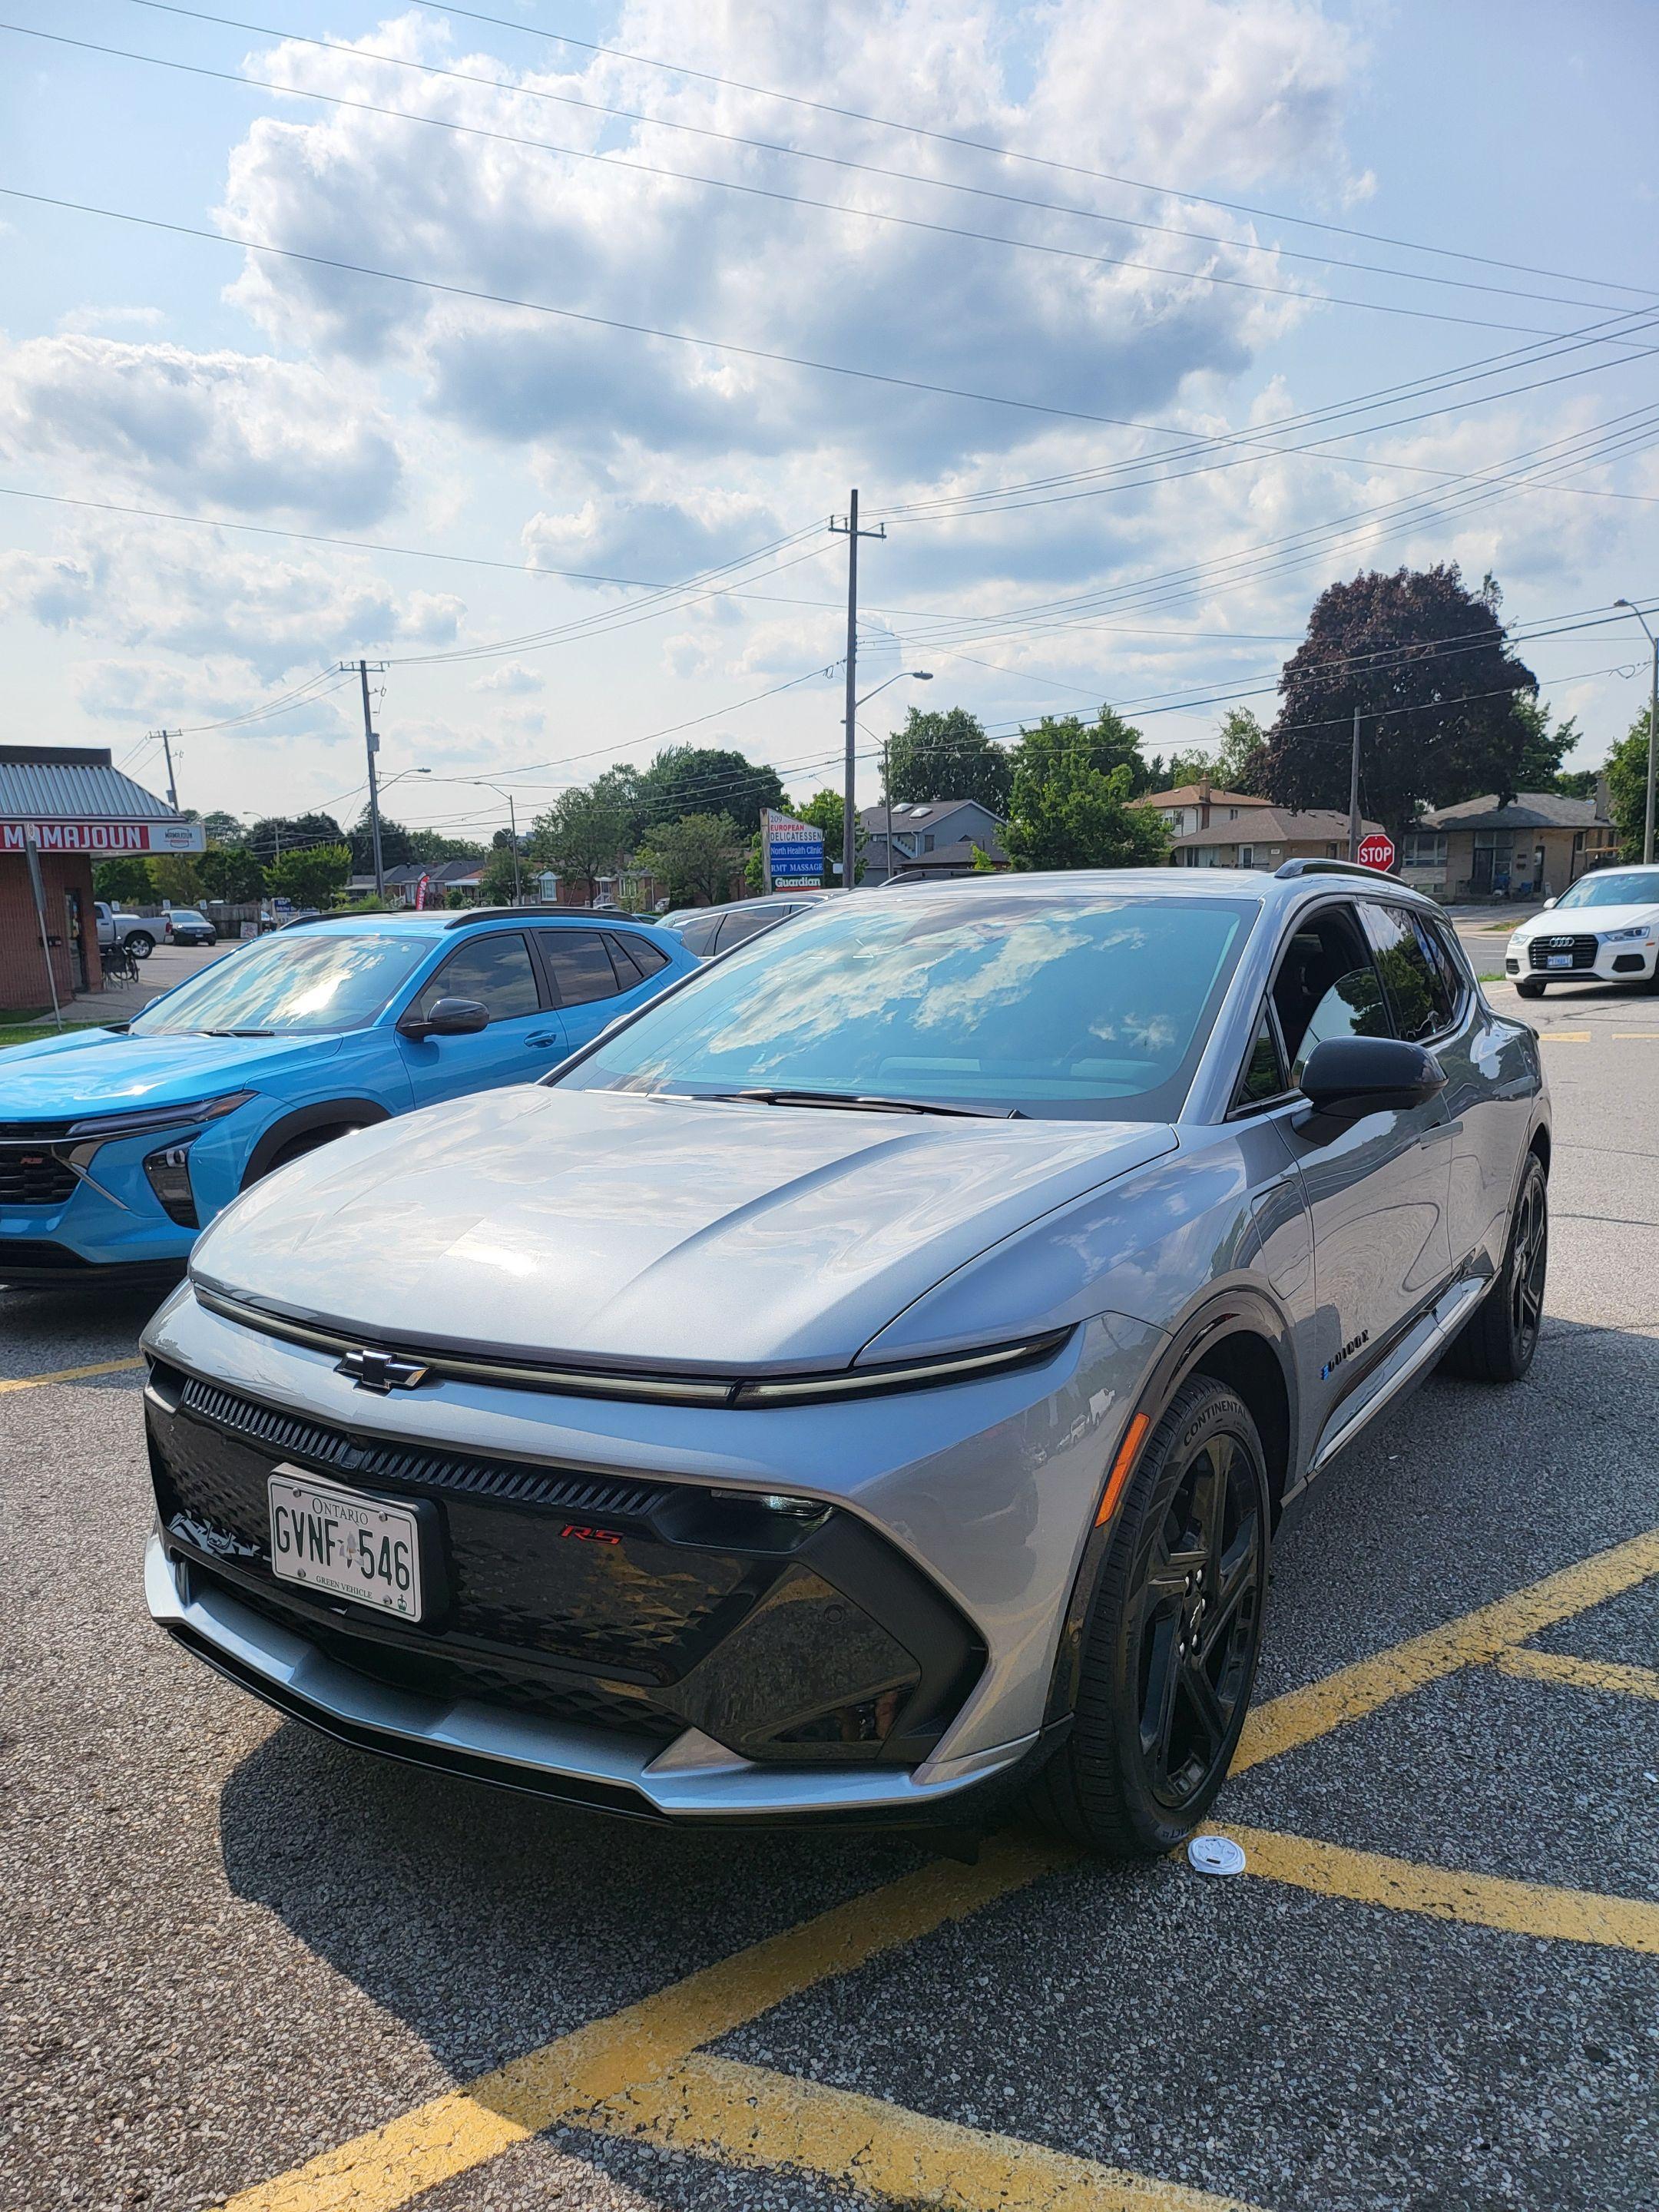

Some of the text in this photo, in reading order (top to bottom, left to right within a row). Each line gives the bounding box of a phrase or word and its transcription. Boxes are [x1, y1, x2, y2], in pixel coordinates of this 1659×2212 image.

[770, 832, 821, 841] DELICATESSEN
[771, 846, 823, 855] North Health Clinic
[1361, 846, 1392, 863] STOP
[790, 863, 823, 872] MASSAGE
[775, 877, 820, 887] Guardian
[312, 1498, 369, 1526] ONTARIO
[561, 1524, 624, 1545] RS
[275, 1505, 410, 1591] GVNF 546
[316, 1575, 373, 1599] GREEN VEHICLE
